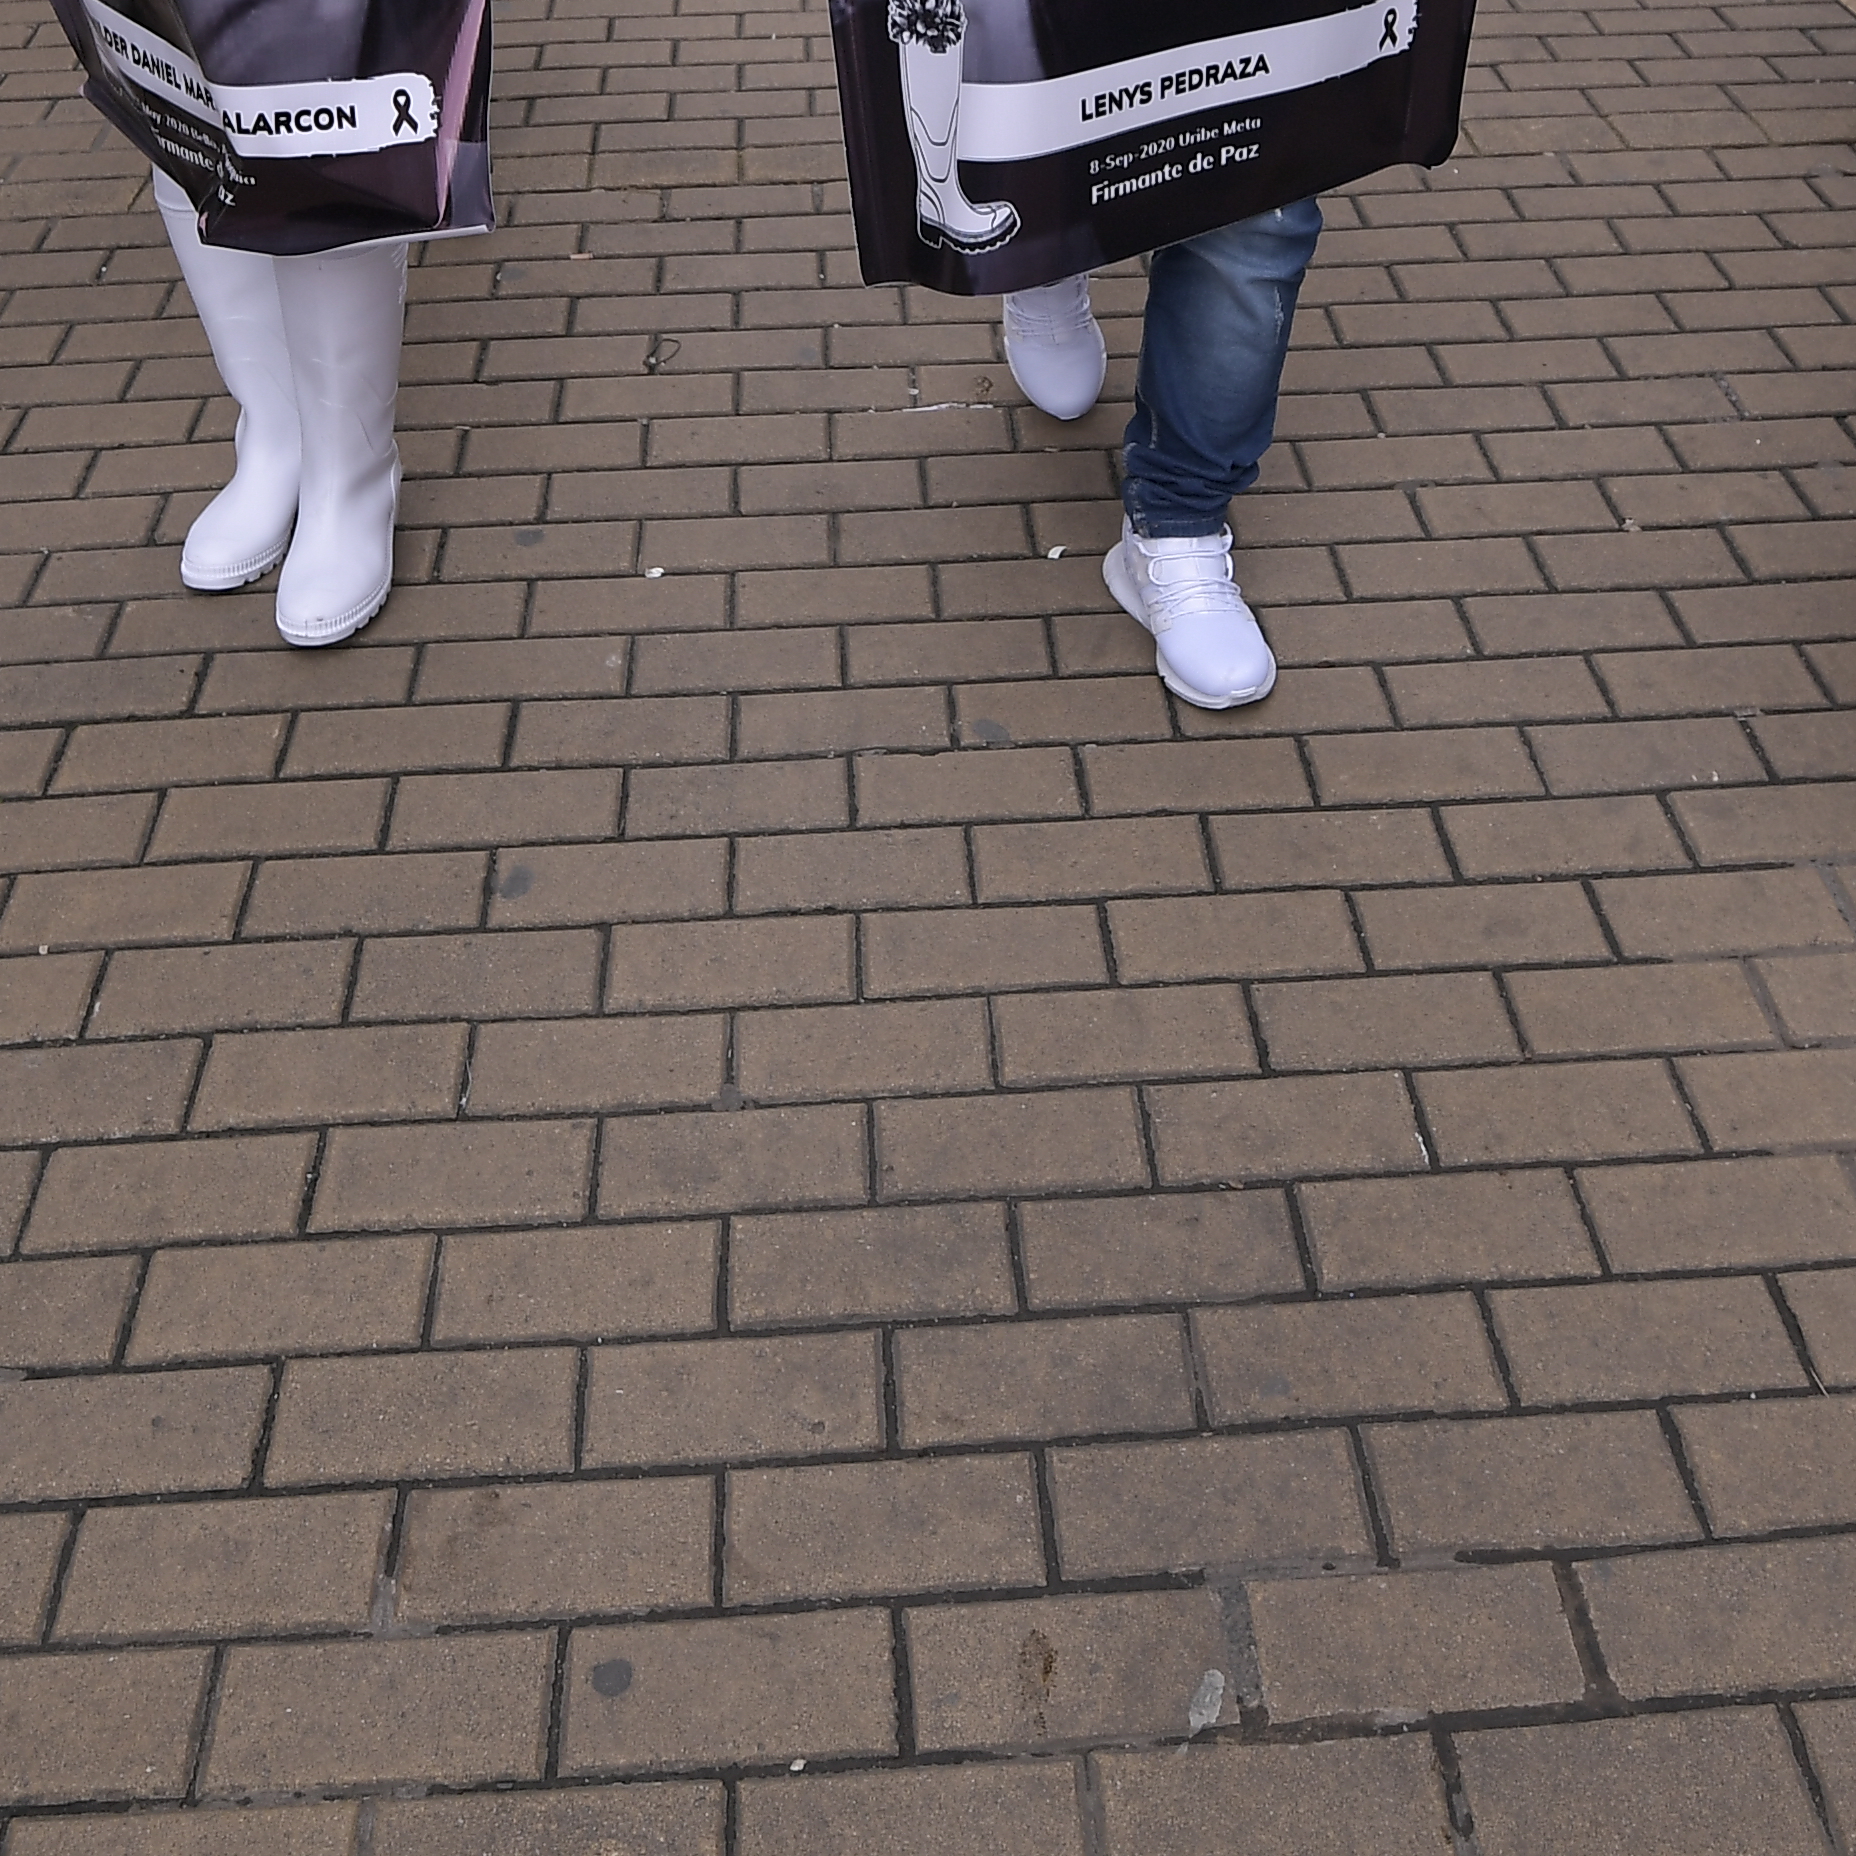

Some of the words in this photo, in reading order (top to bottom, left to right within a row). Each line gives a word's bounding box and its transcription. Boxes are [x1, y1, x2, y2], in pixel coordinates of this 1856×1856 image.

[130, 43, 182, 92] DANIEL
[222, 105, 358, 137] ALARCON
[1081, 83, 1153, 122] LENYS
[1160, 54, 1269, 99] PEDRAZA
[1090, 137, 1174, 174] 8-Sep-2020
[1179, 123, 1220, 150] Uribe
[1223, 115, 1262, 138] Meta
[1090, 162, 1183, 206] Firmante
[1188, 149, 1215, 173] de
[1220, 141, 1261, 166] Paz
